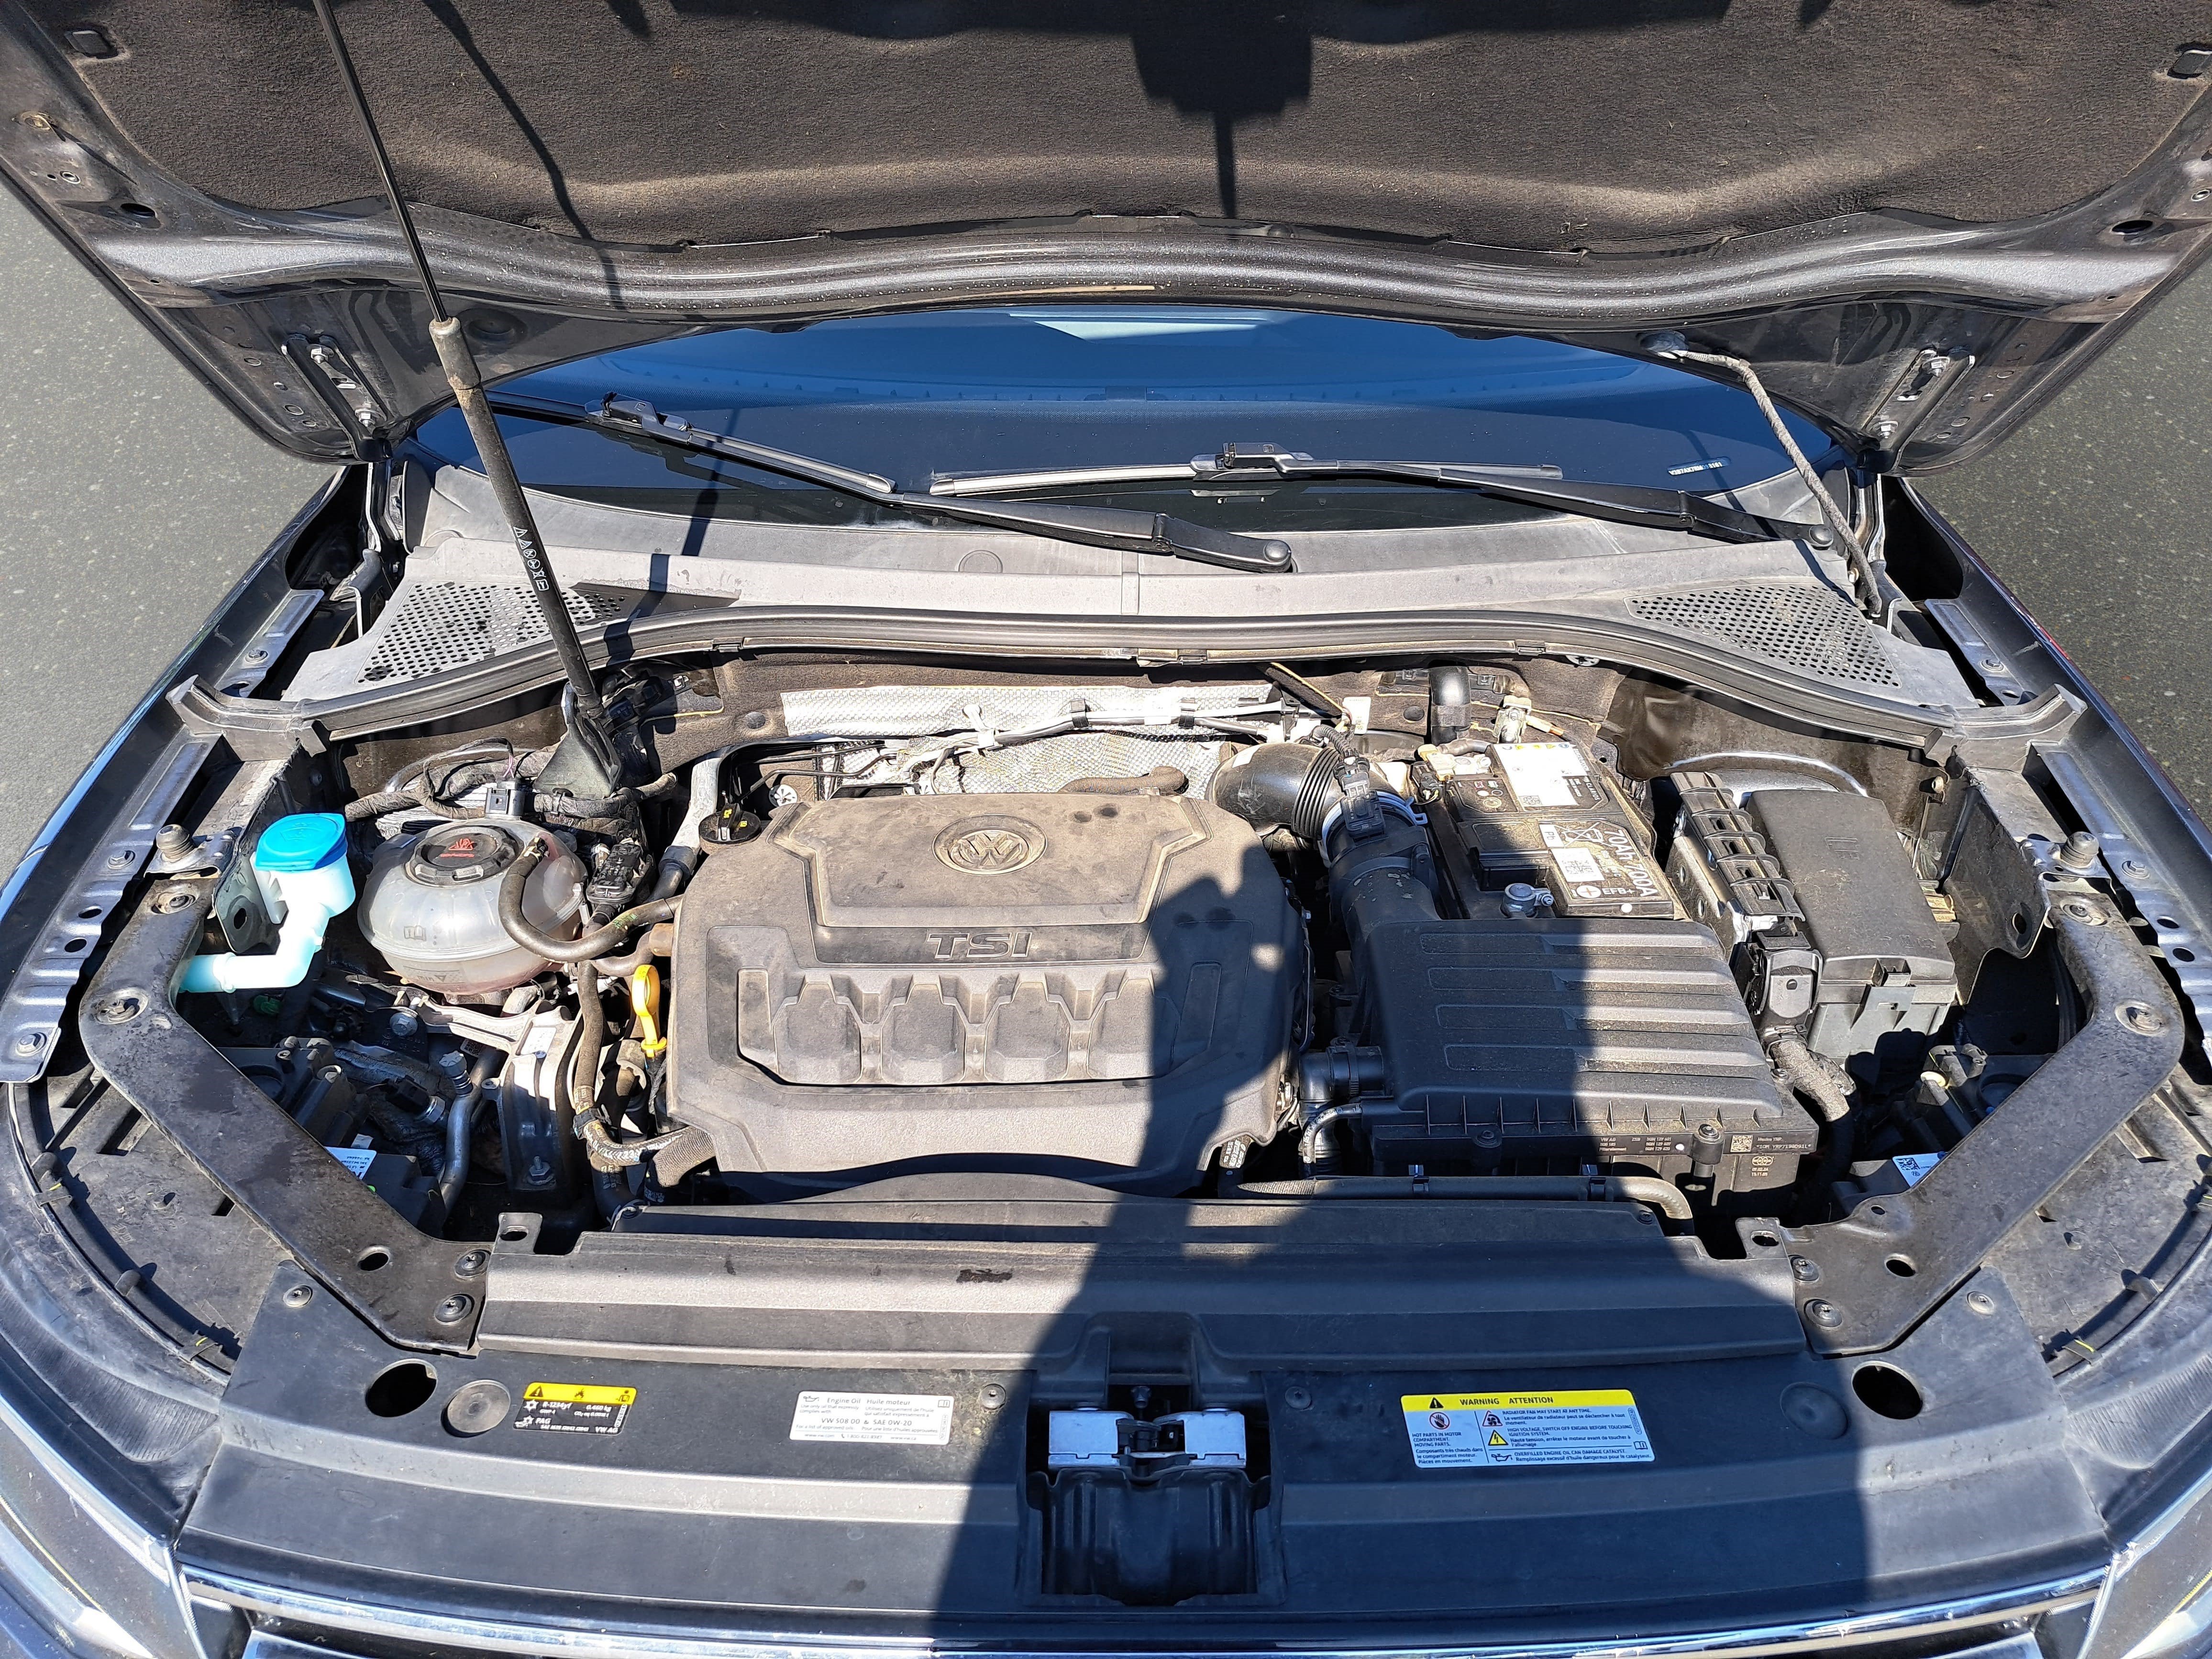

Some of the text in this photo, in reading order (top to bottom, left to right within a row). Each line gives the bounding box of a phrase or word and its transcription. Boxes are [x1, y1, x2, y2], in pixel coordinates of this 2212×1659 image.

[1585, 783, 1600, 801] CLARIOS
[1544, 831, 1554, 840] Pb
[1604, 830, 1636, 861] 70Ah
[1624, 864, 1658, 897] 700A
[927, 931, 1033, 959] TSI
[542, 1401, 573, 1410] R-1234yf
